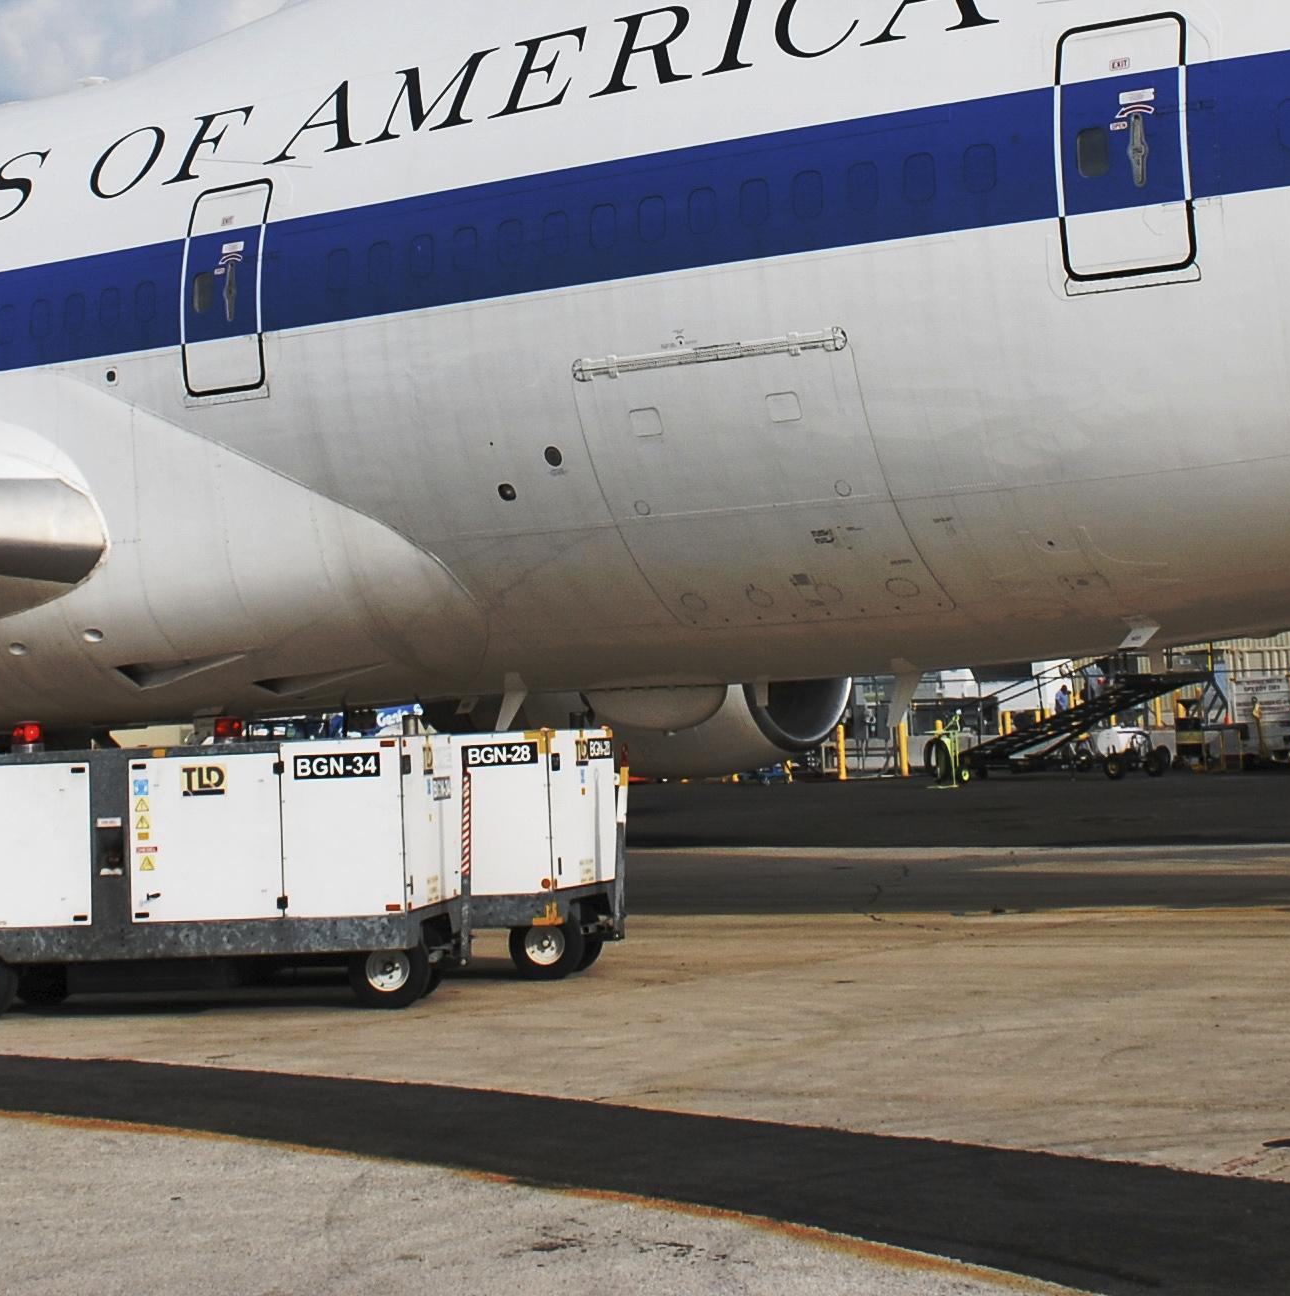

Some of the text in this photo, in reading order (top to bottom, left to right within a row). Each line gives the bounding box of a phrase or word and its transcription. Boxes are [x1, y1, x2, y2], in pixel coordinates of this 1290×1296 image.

[90, 105, 254, 199] OF
[296, 755, 377, 777] BGN-34
[467, 744, 532, 765] BGN-28
[182, 766, 225, 790] TLD
